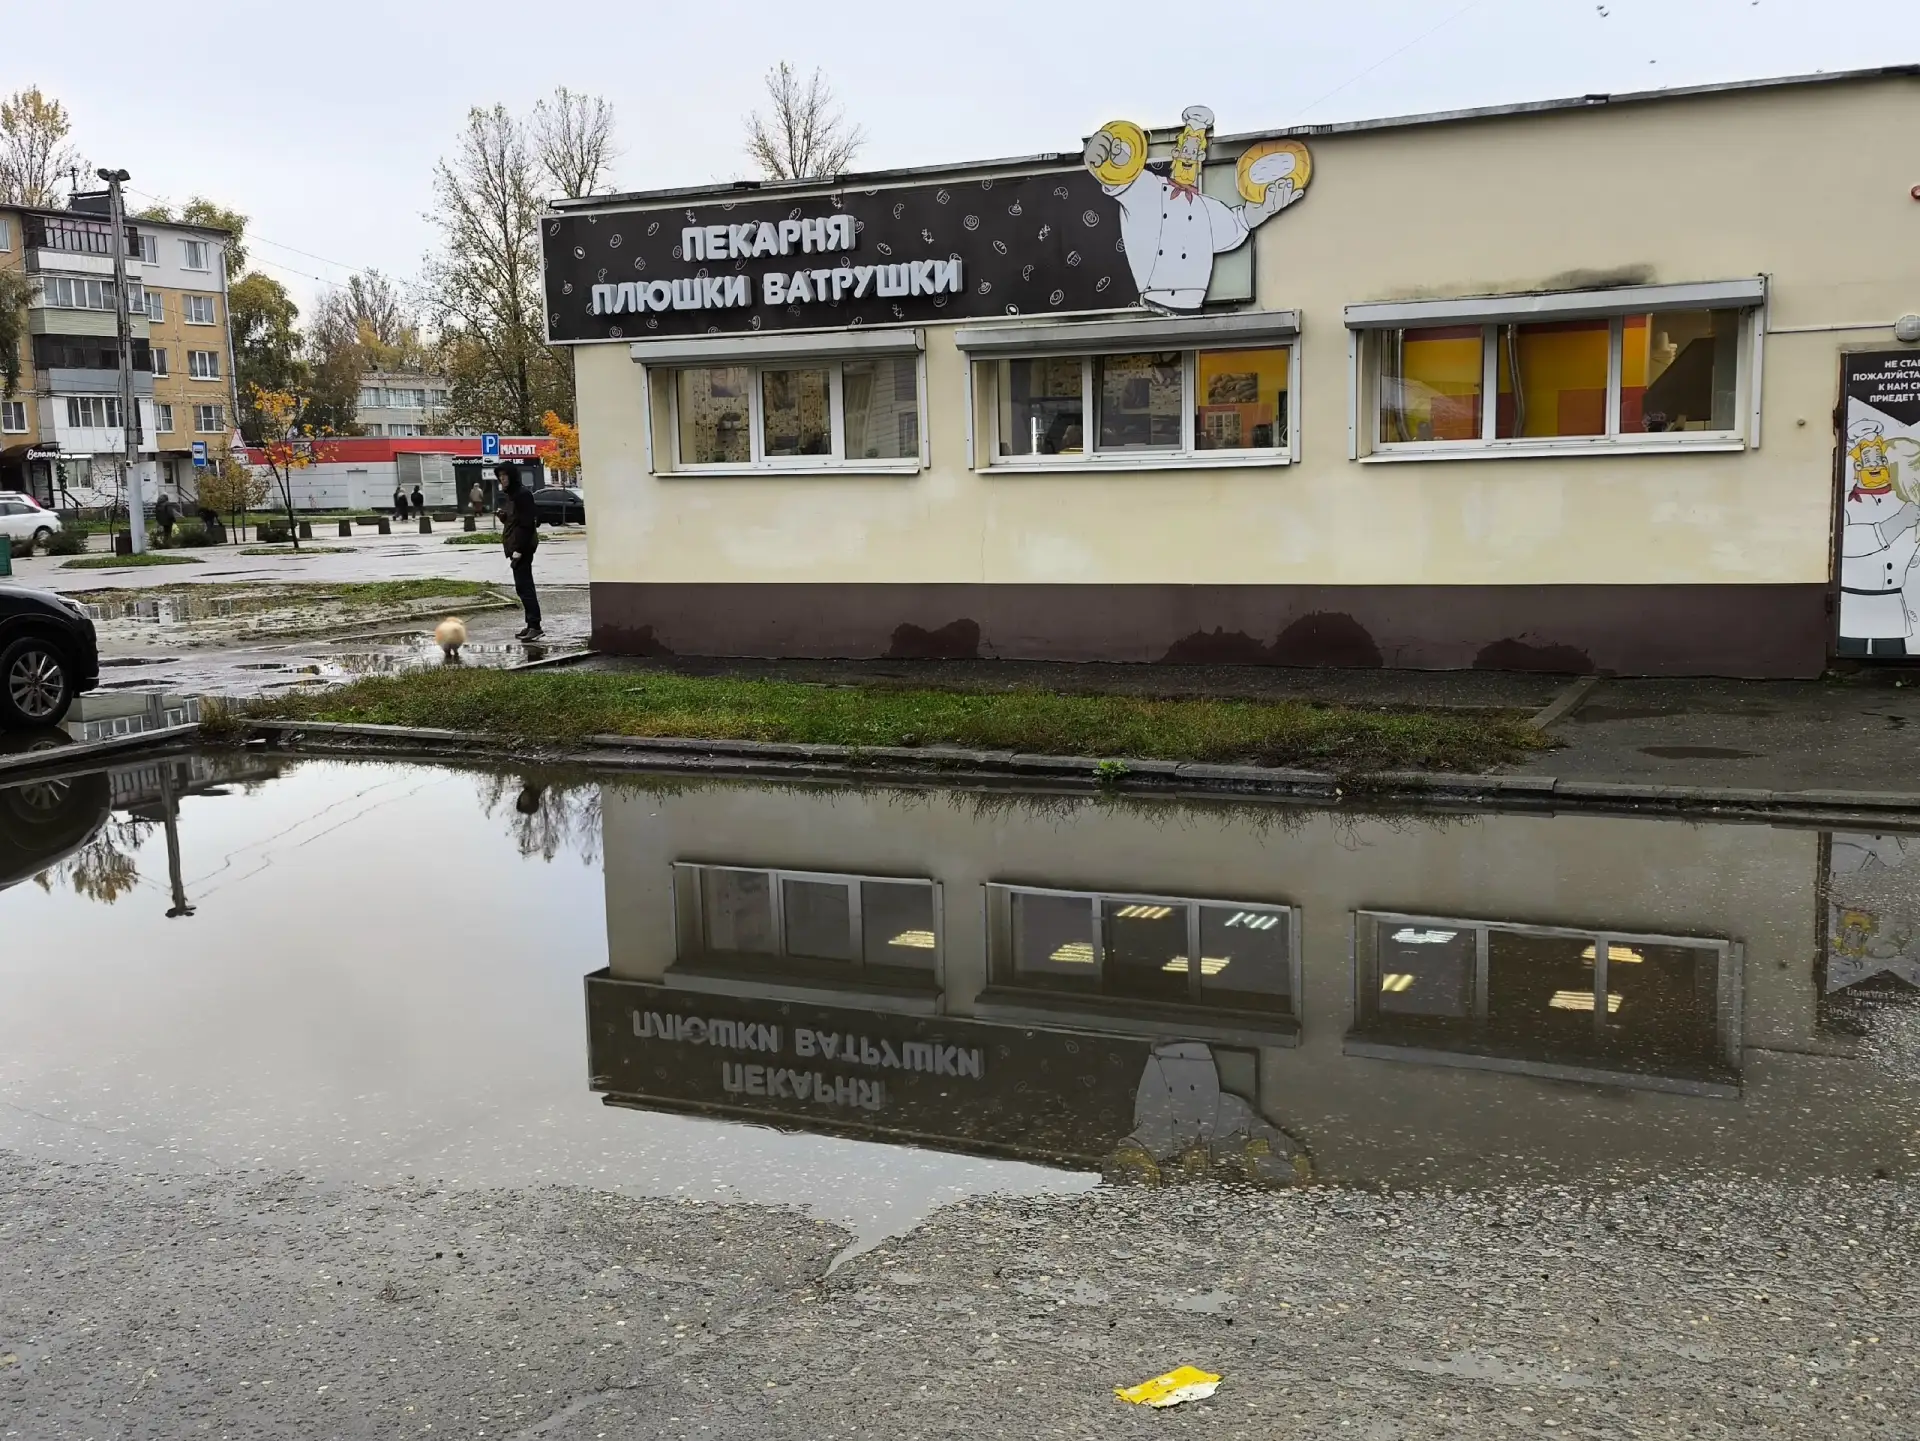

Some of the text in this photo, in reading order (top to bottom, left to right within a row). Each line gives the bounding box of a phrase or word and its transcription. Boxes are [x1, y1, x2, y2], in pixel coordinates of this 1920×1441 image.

[682, 214, 856, 262] ПЕКАРНЯ
[591, 258, 963, 315] ПЛЮШКИ ВАТРУШКИ
[1884, 360, 1898, 368] НЕ
[1852, 369, 1920, 381] ПОЖАЛУЙСТА
[1878, 383, 1885, 391] К
[1886, 382, 1909, 390] НАМ
[1869, 393, 1915, 402] ПРИЕДЕТ
[486, 436, 496, 453] P
[500, 444, 537, 455] МАГНИТ
